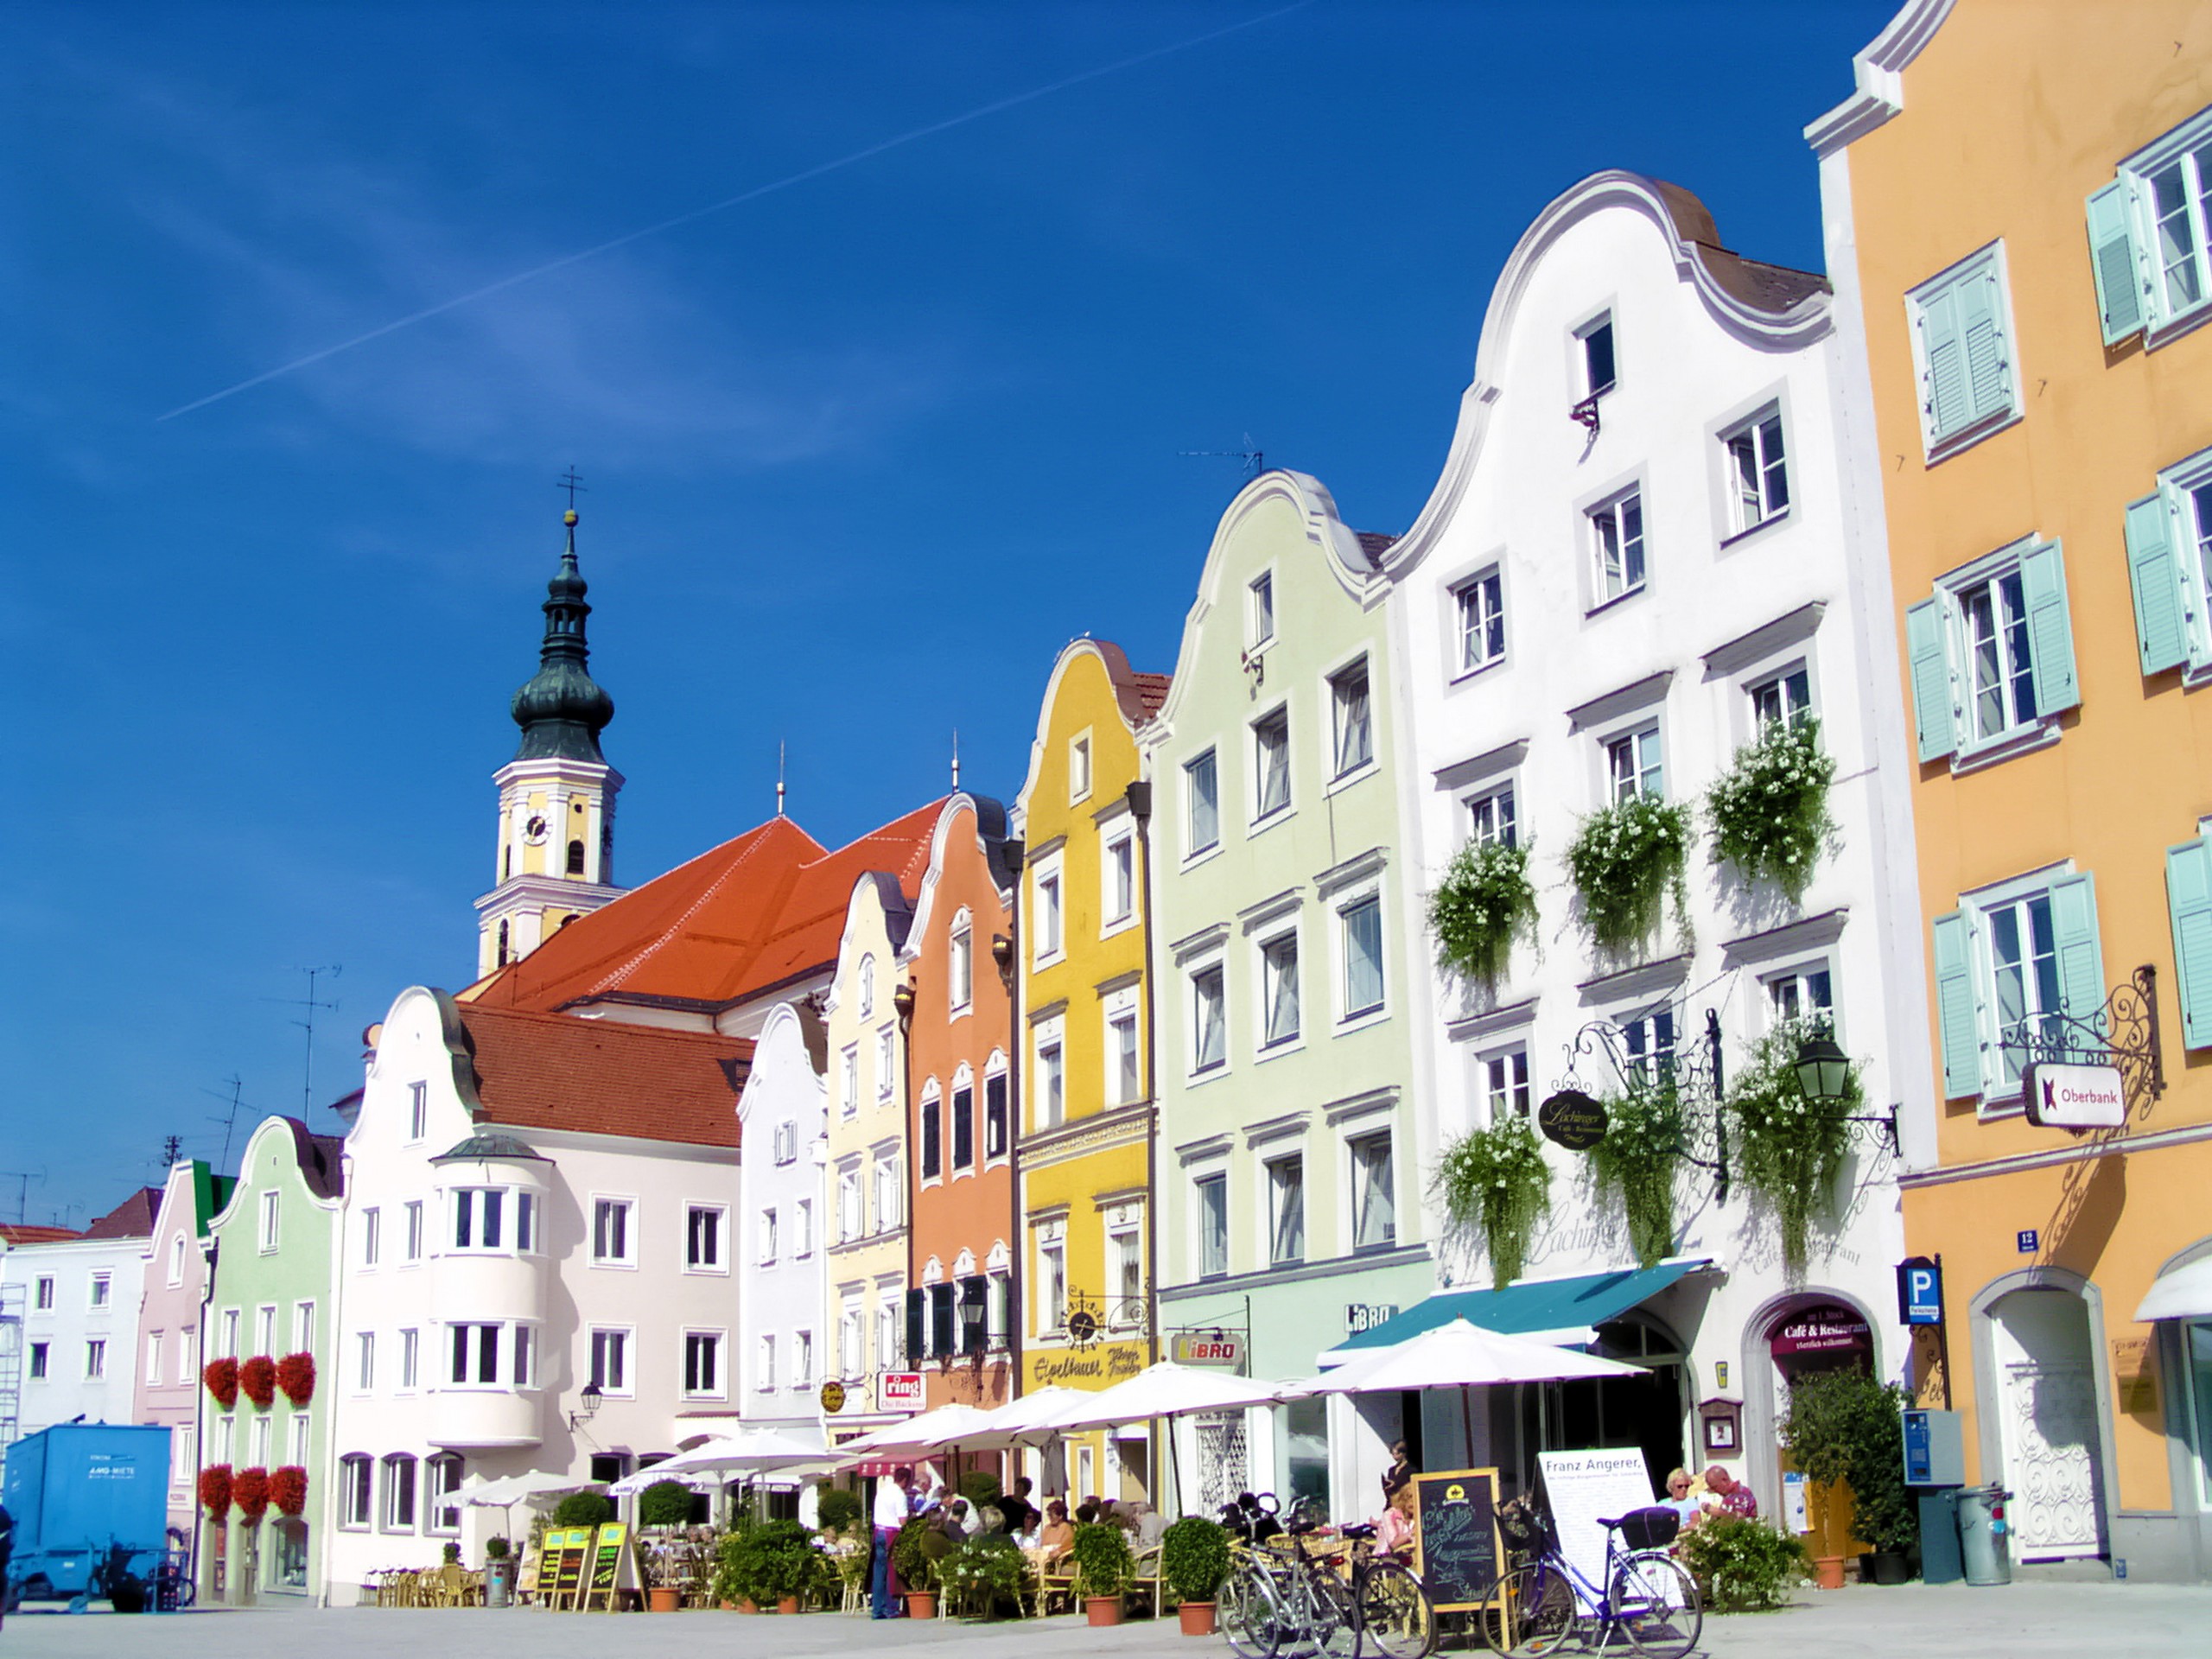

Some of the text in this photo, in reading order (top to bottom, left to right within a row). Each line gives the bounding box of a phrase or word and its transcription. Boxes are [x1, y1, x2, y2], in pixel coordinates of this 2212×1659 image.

[2061, 1088, 2118, 1103] Oberbank
[2021, 1232, 2033, 1244] 12
[1752, 1243, 1780, 1275] Café
[1911, 1271, 1932, 1304] P
[1784, 1322, 1868, 1338] Café & Restaurant
[887, 1376, 919, 1398] ring
[1546, 1459, 1642, 1472] Franz Angerer,
